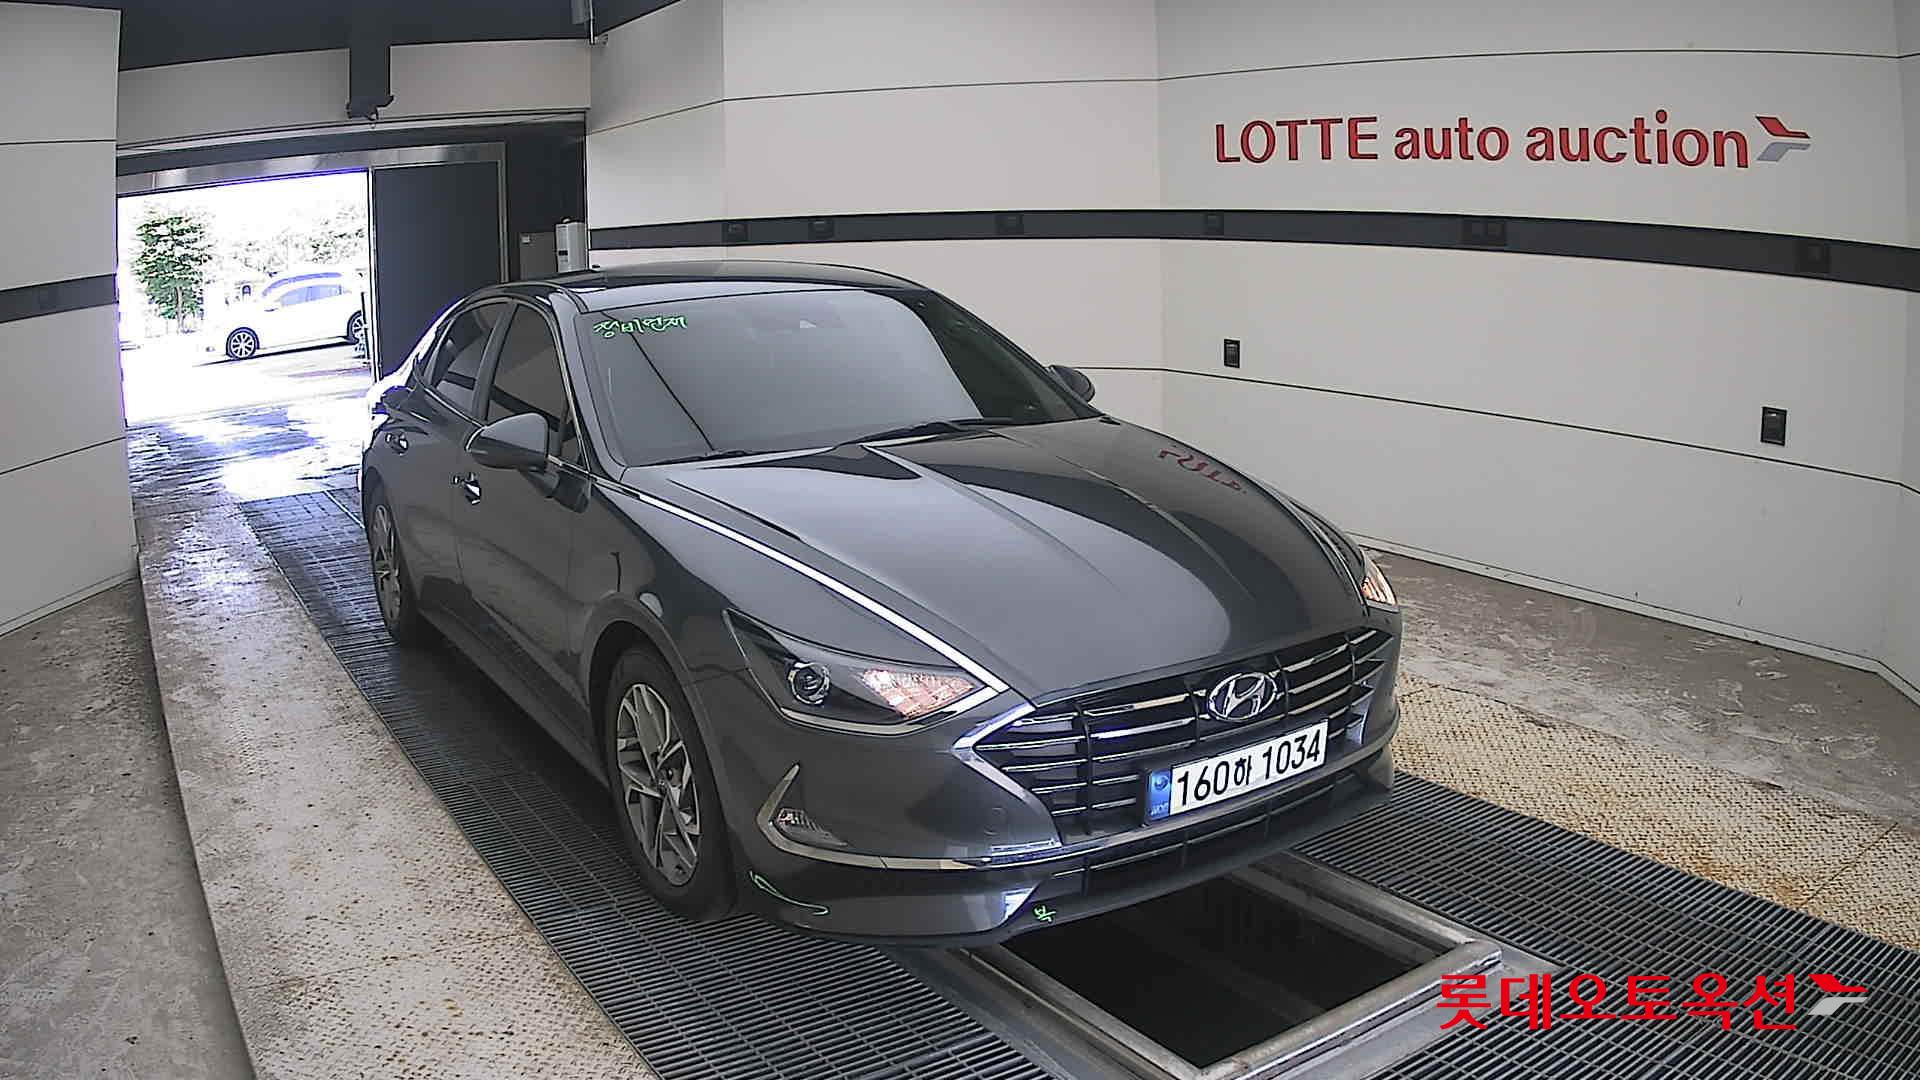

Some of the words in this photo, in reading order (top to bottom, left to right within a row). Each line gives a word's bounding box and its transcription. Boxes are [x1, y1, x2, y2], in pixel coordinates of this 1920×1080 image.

[1215, 116, 1379, 163] LOTTE
[1393, 117, 1510, 163] auto
[1525, 109, 1750, 169] auction
[1177, 755, 1252, 806] 160하
[1262, 729, 1321, 780] 1034
